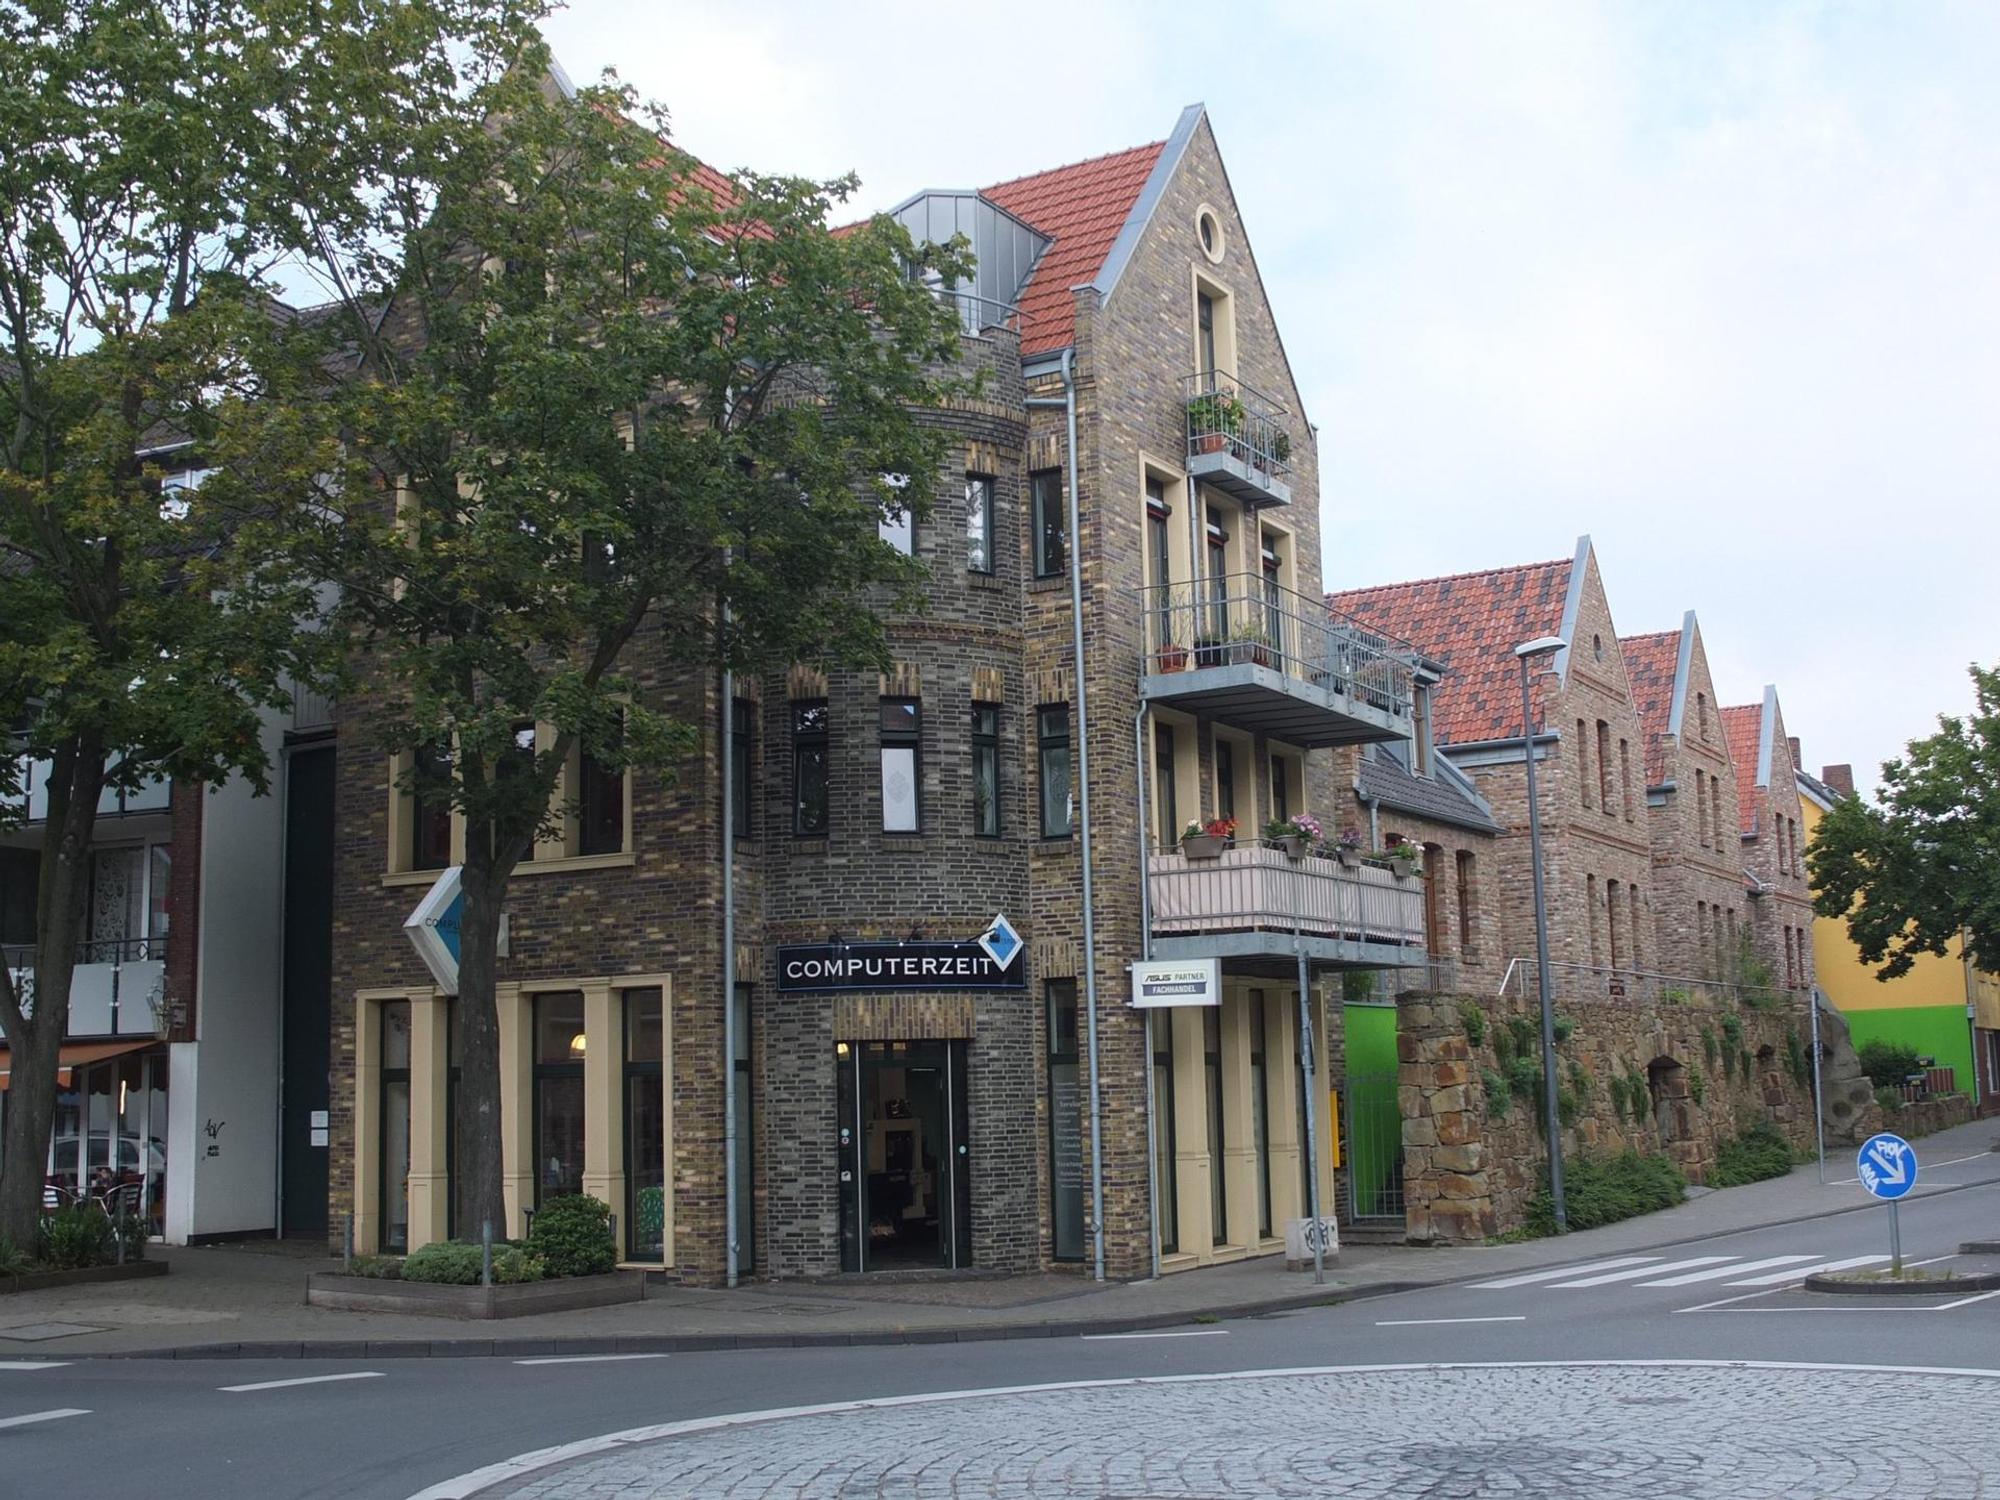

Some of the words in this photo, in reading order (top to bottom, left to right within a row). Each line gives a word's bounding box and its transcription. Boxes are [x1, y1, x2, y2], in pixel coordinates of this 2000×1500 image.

[786, 957, 992, 979] COMPUTERZEIT
[1145, 974, 1172, 982] ASUS
[1174, 972, 1205, 981] PARTNER
[1152, 985, 1197, 994] FACHHANDEL
